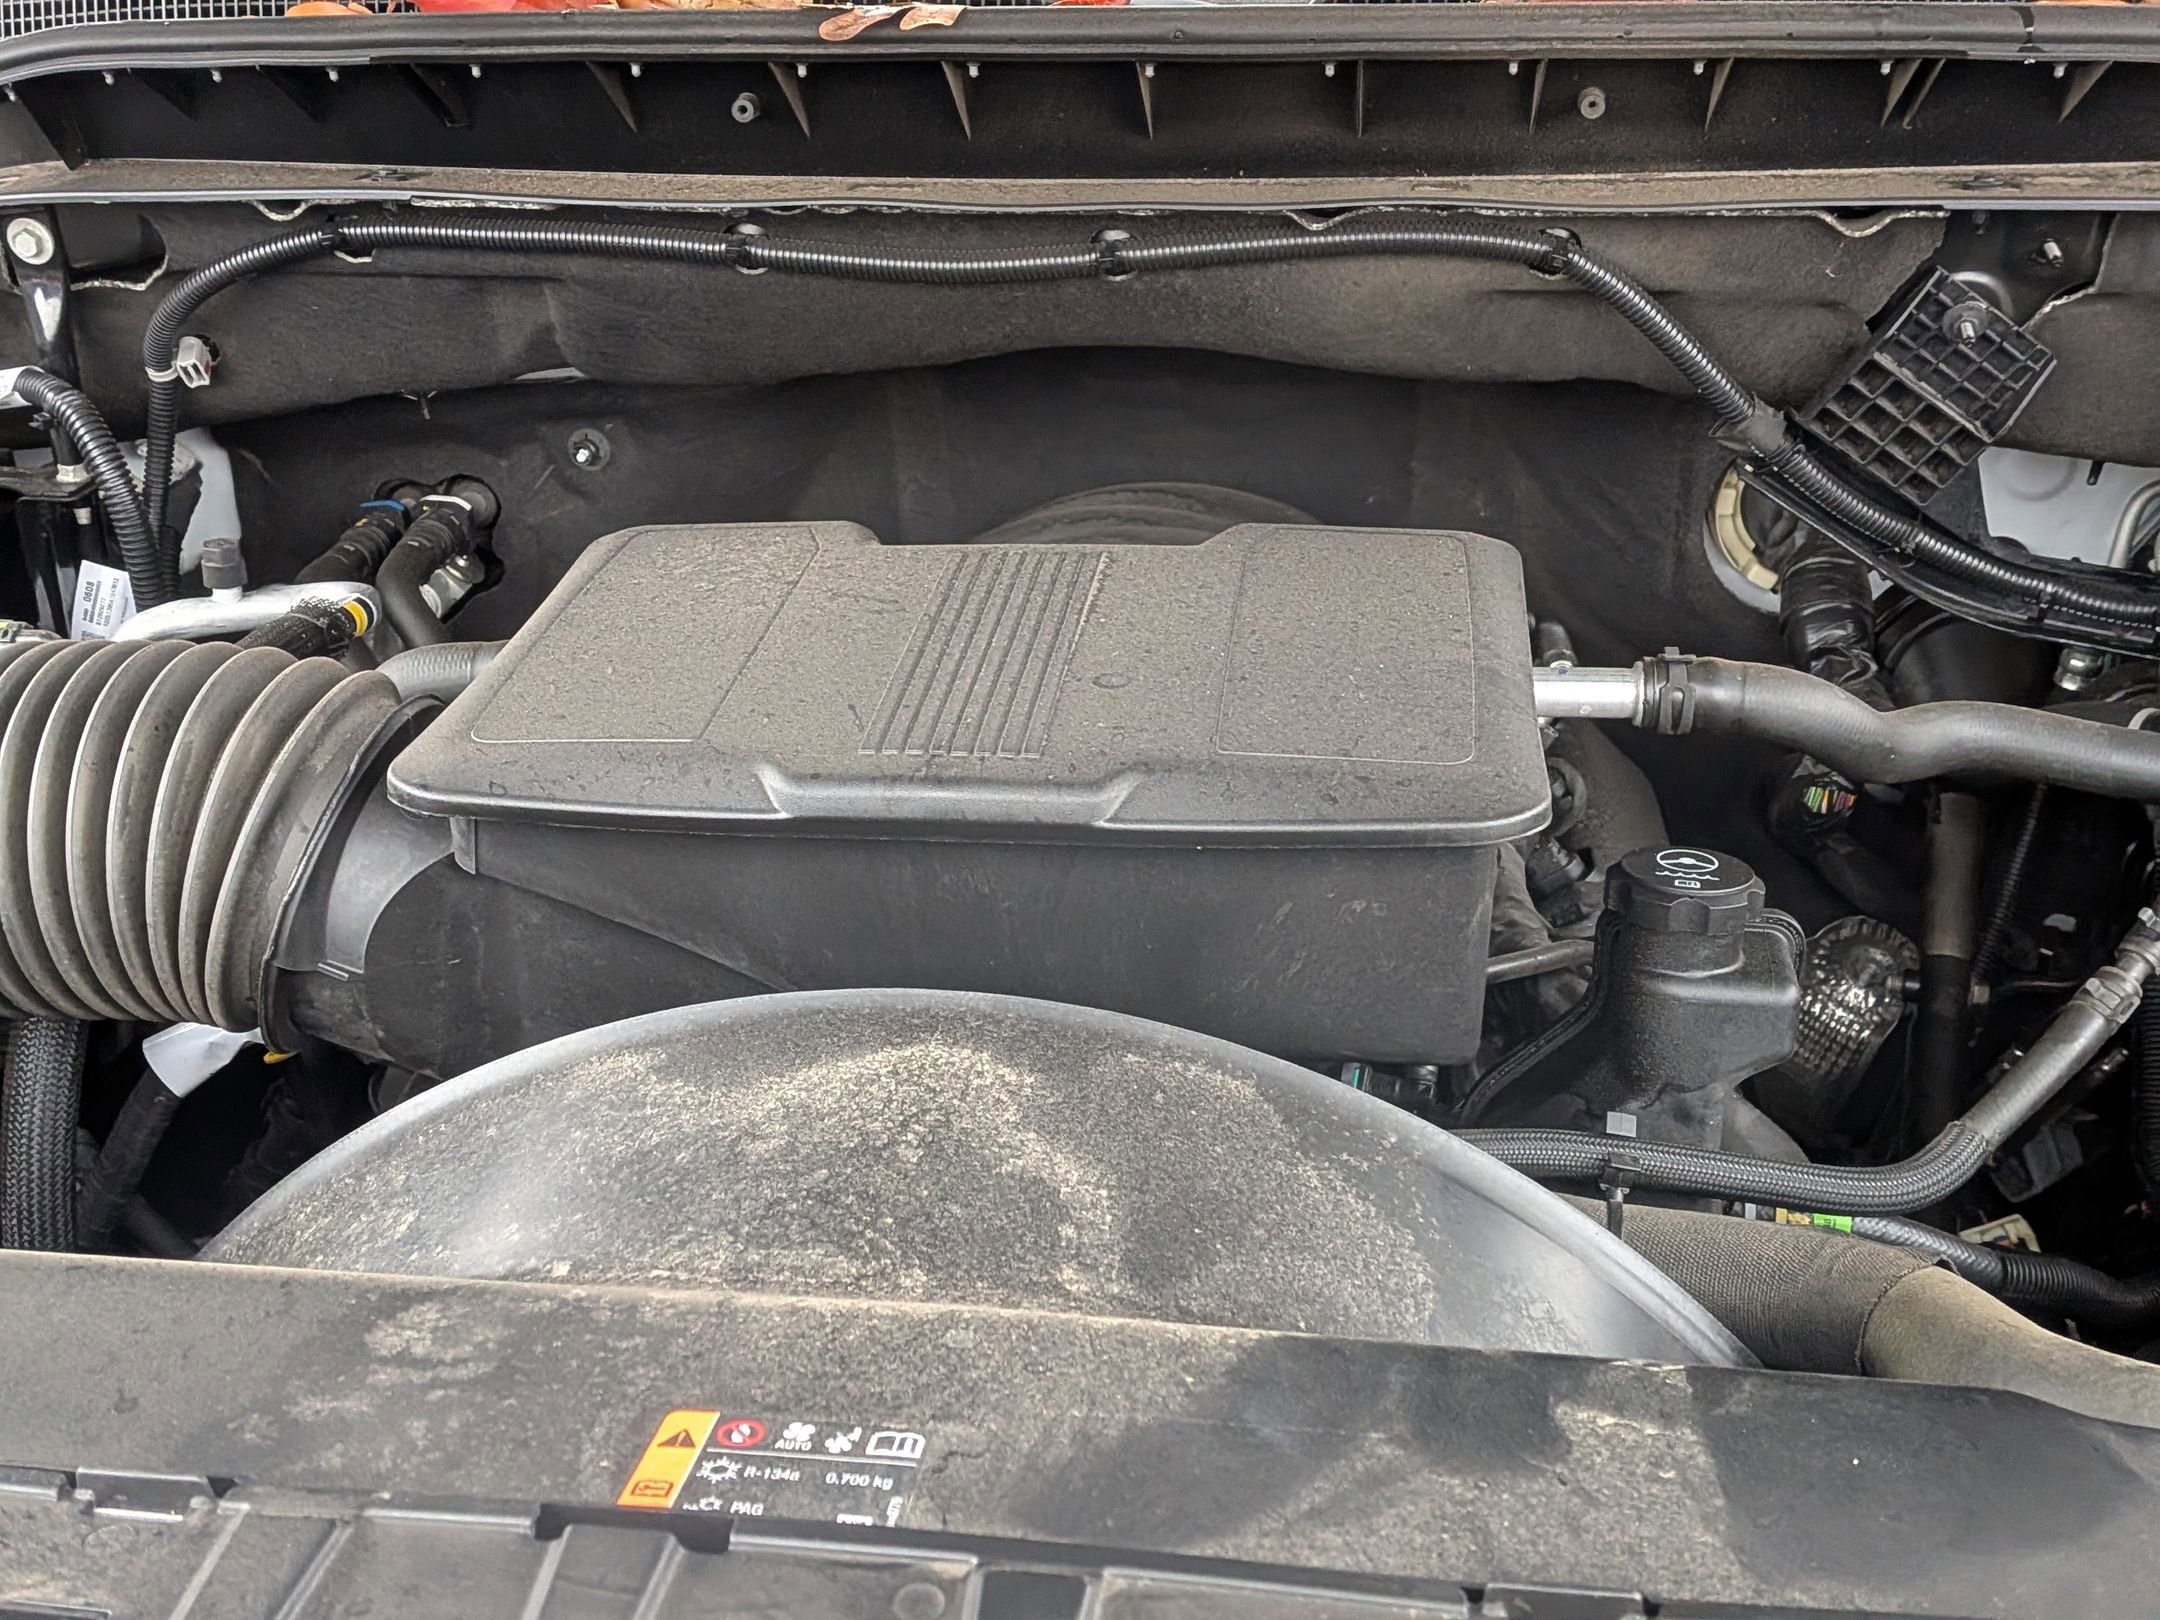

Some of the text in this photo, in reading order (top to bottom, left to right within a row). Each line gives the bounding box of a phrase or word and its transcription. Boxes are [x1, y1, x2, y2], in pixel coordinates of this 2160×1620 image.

[775, 1439, 812, 1451] AUTO
[743, 1465, 894, 1491] R-134a 0.700 kg
[730, 1501, 764, 1516] PAG
